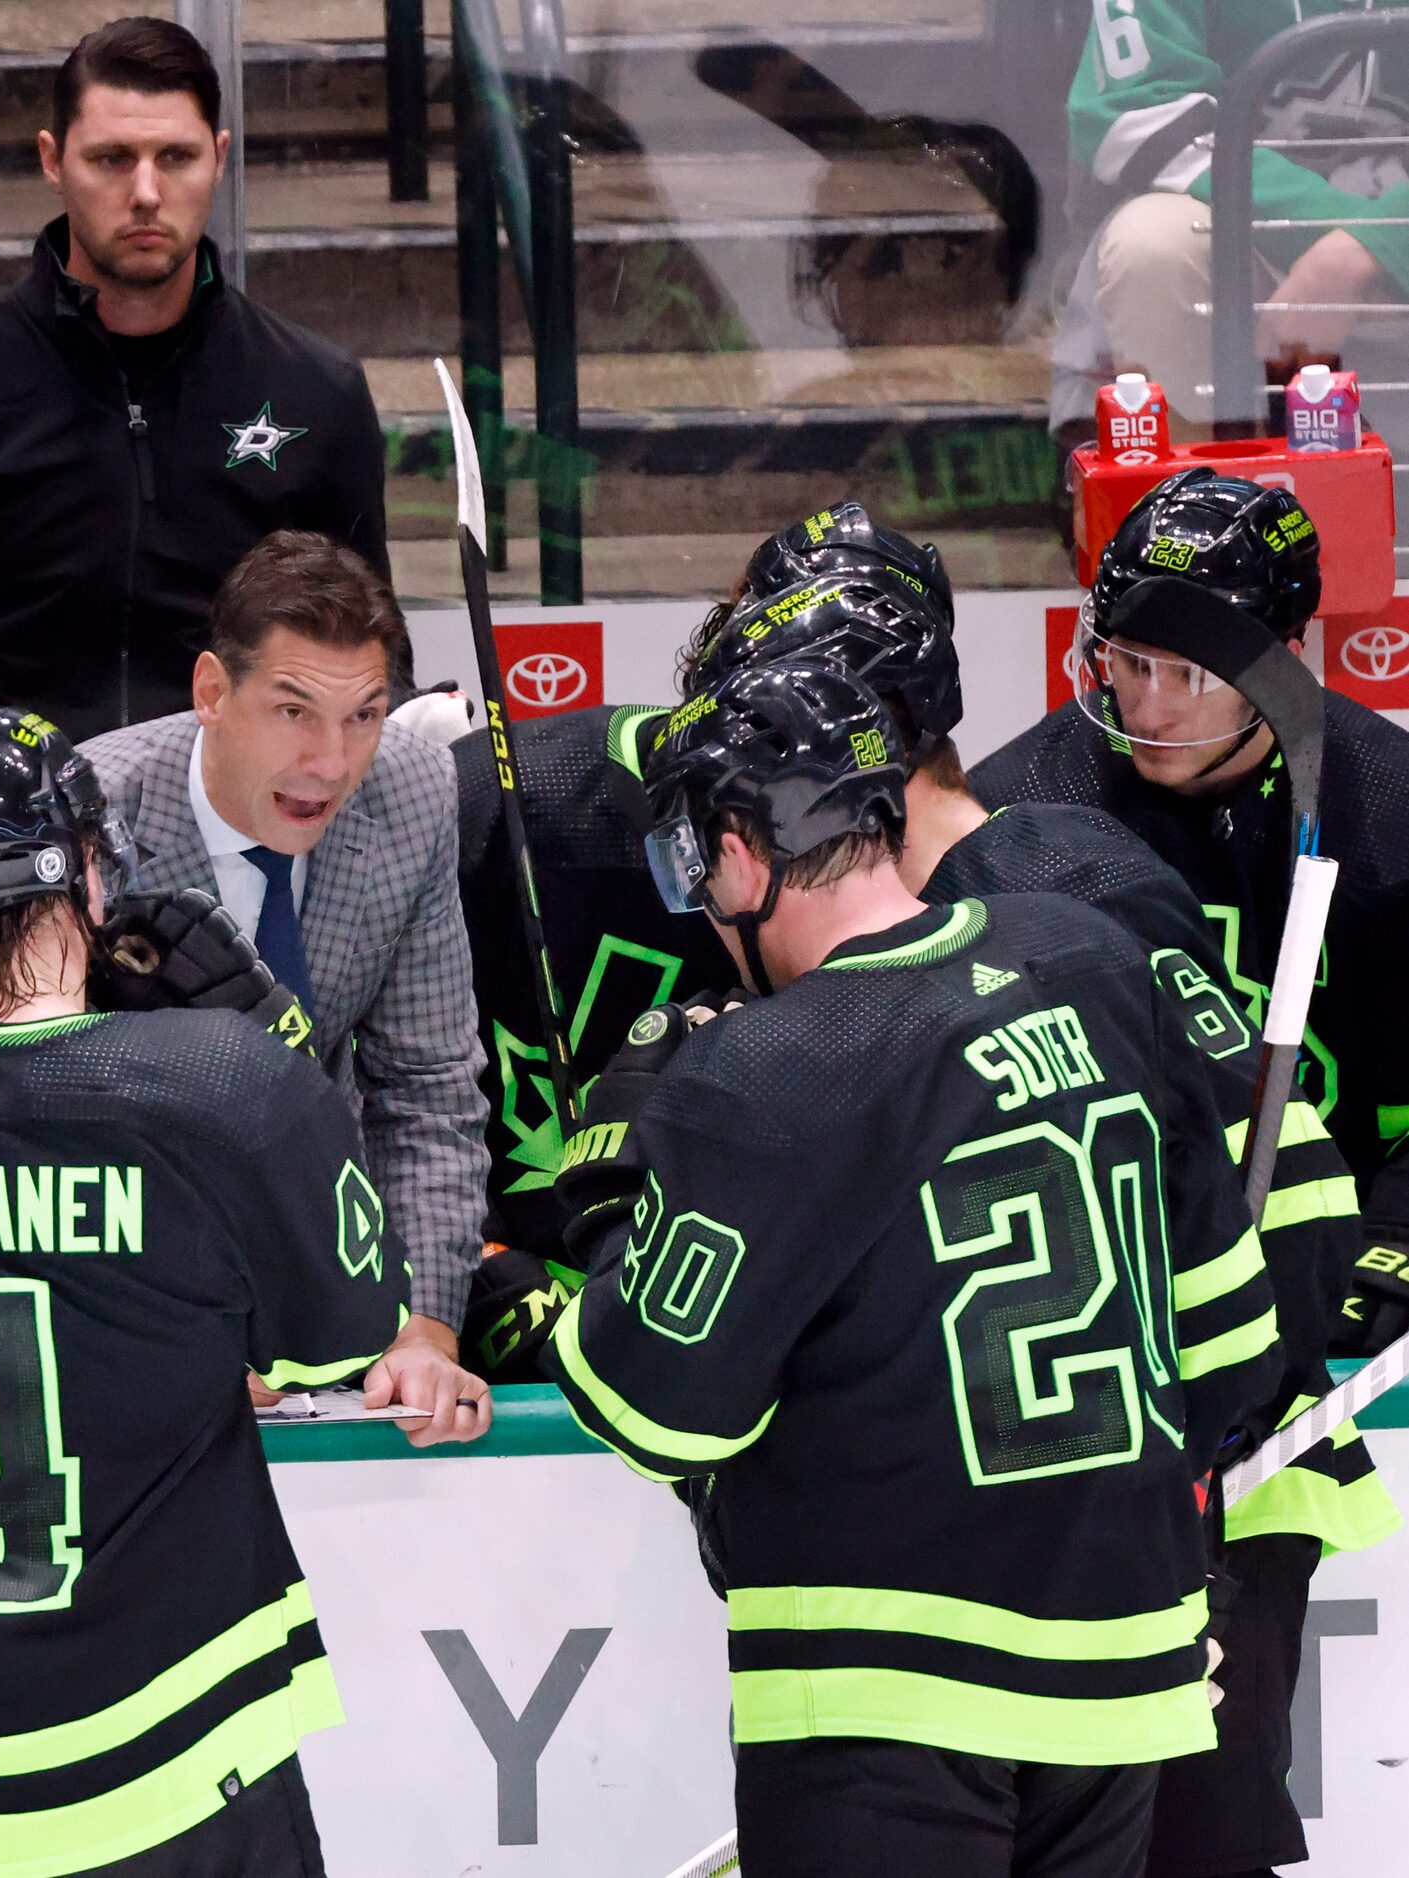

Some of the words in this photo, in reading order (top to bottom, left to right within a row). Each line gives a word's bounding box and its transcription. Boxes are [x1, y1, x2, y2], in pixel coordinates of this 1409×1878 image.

[1110, 415, 1158, 437] BIO
[1292, 409, 1339, 429] BIO
[1294, 429, 1340, 440] STEEL
[1111, 437, 1158, 449] STEEL
[1147, 534, 1198, 572] 23
[765, 584, 820, 618] ENERGY
[771, 587, 844, 628] TRANSFER
[668, 698, 720, 738] TRANSFER
[669, 691, 709, 727] ENERGY
[486, 699, 515, 792] CCM
[850, 729, 889, 770] 20
[973, 969, 1021, 996] adidas
[963, 1004, 1106, 1112] SUTER
[918, 1090, 1186, 1487] 20
[420, 1626, 614, 1846] Y
